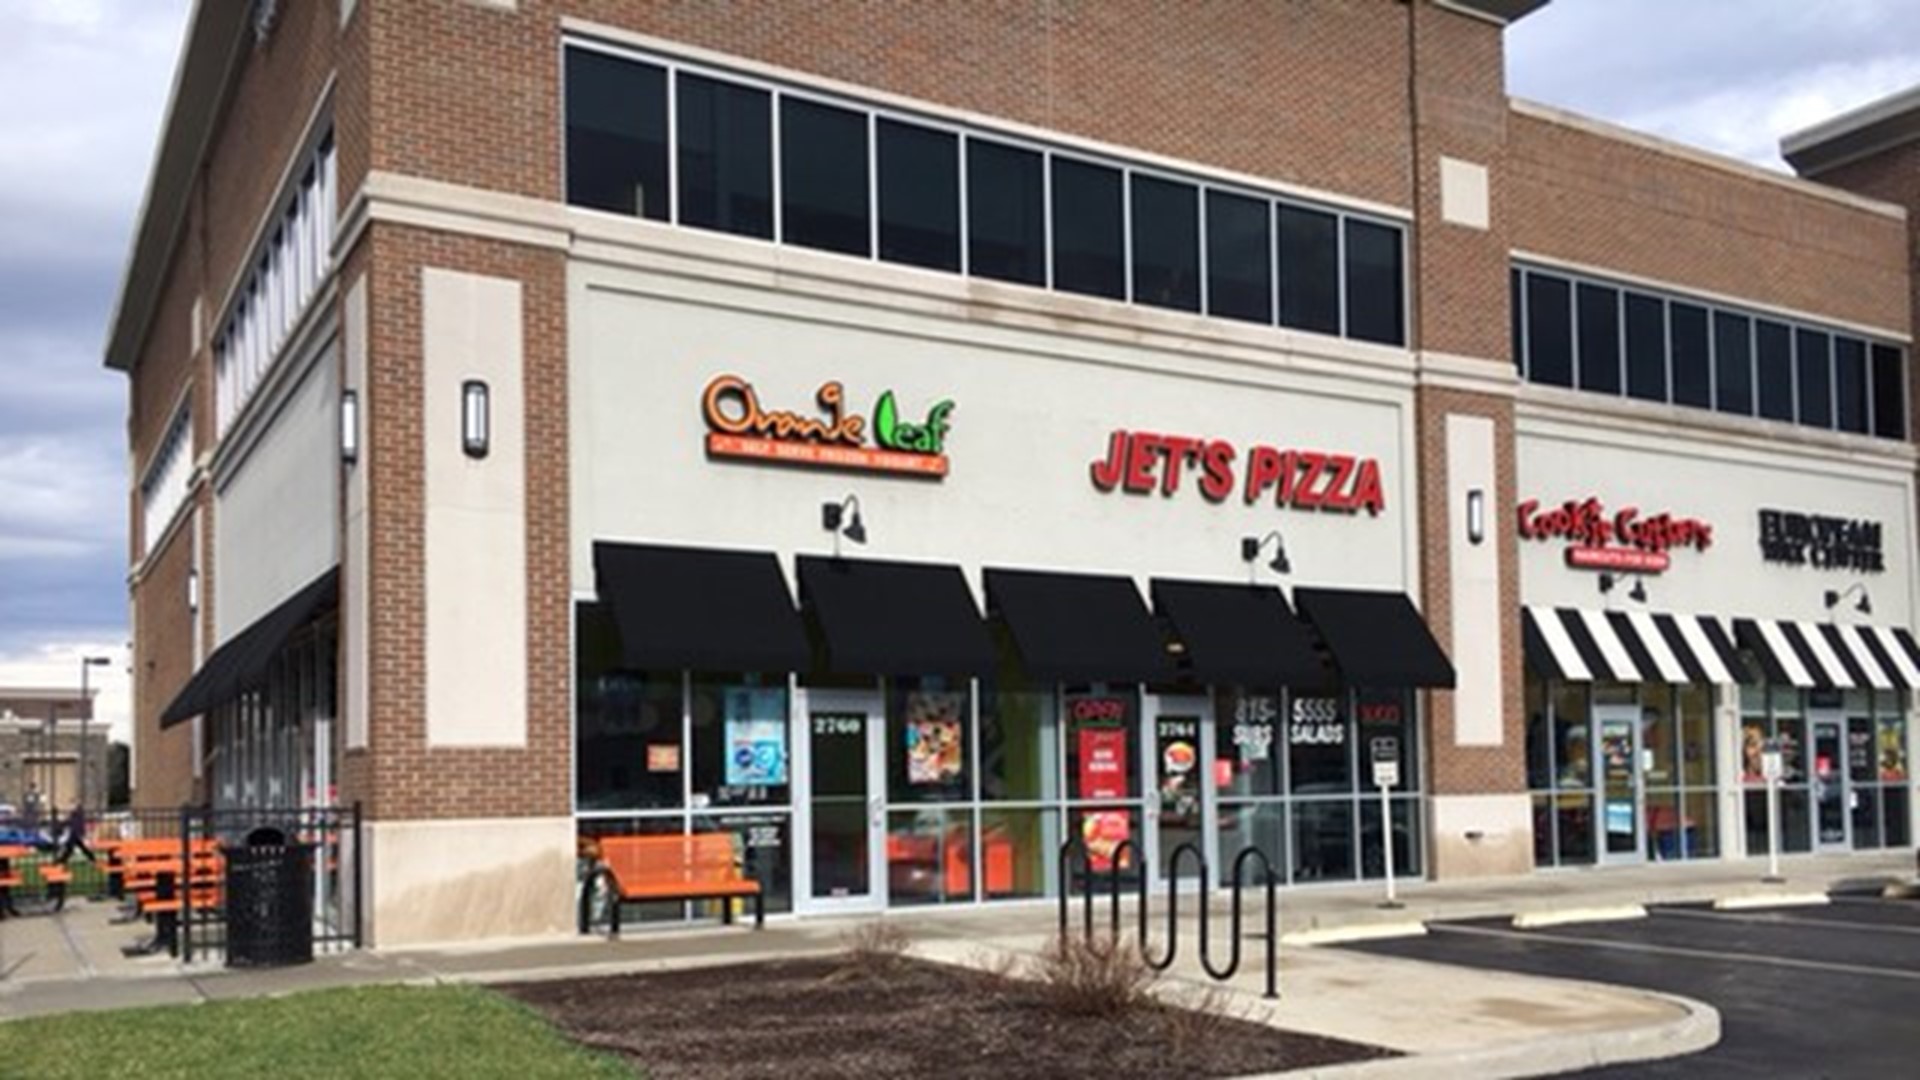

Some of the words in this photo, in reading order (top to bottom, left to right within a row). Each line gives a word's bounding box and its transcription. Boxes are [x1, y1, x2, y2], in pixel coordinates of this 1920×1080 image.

[702, 374, 867, 443] Orange
[1090, 430, 1236, 504] JET'S
[1243, 445, 1385, 517] PIZZA
[1758, 509, 1882, 550] EUROPEAN
[814, 717, 861, 735] 2760
[1290, 723, 1345, 745] SALADS
